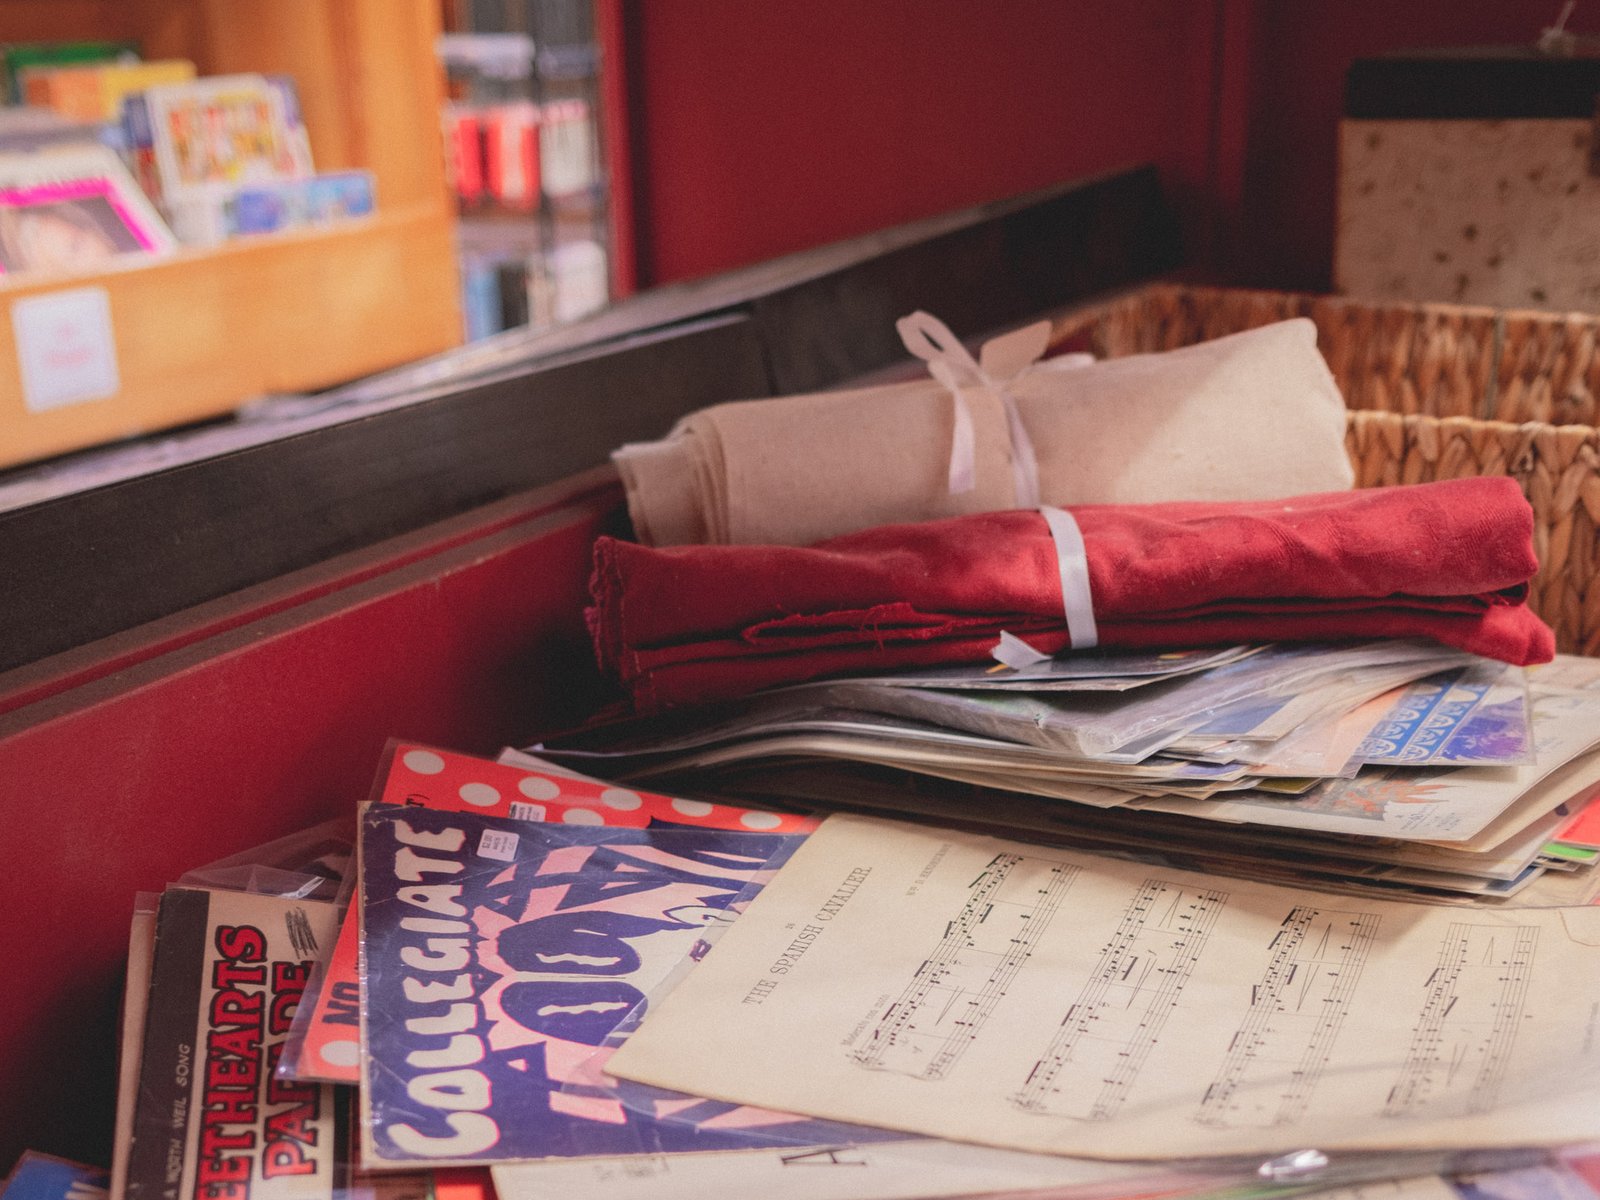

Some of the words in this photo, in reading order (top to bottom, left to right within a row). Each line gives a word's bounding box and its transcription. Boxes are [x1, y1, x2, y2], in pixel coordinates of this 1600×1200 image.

[386, 819, 500, 1157] COLLEGIATE
[741, 979, 779, 1005] THE
[769, 924, 824, 975] SPANISH
[175, 1043, 191, 1088] SONG
[171, 1097, 187, 1129] WEIL
